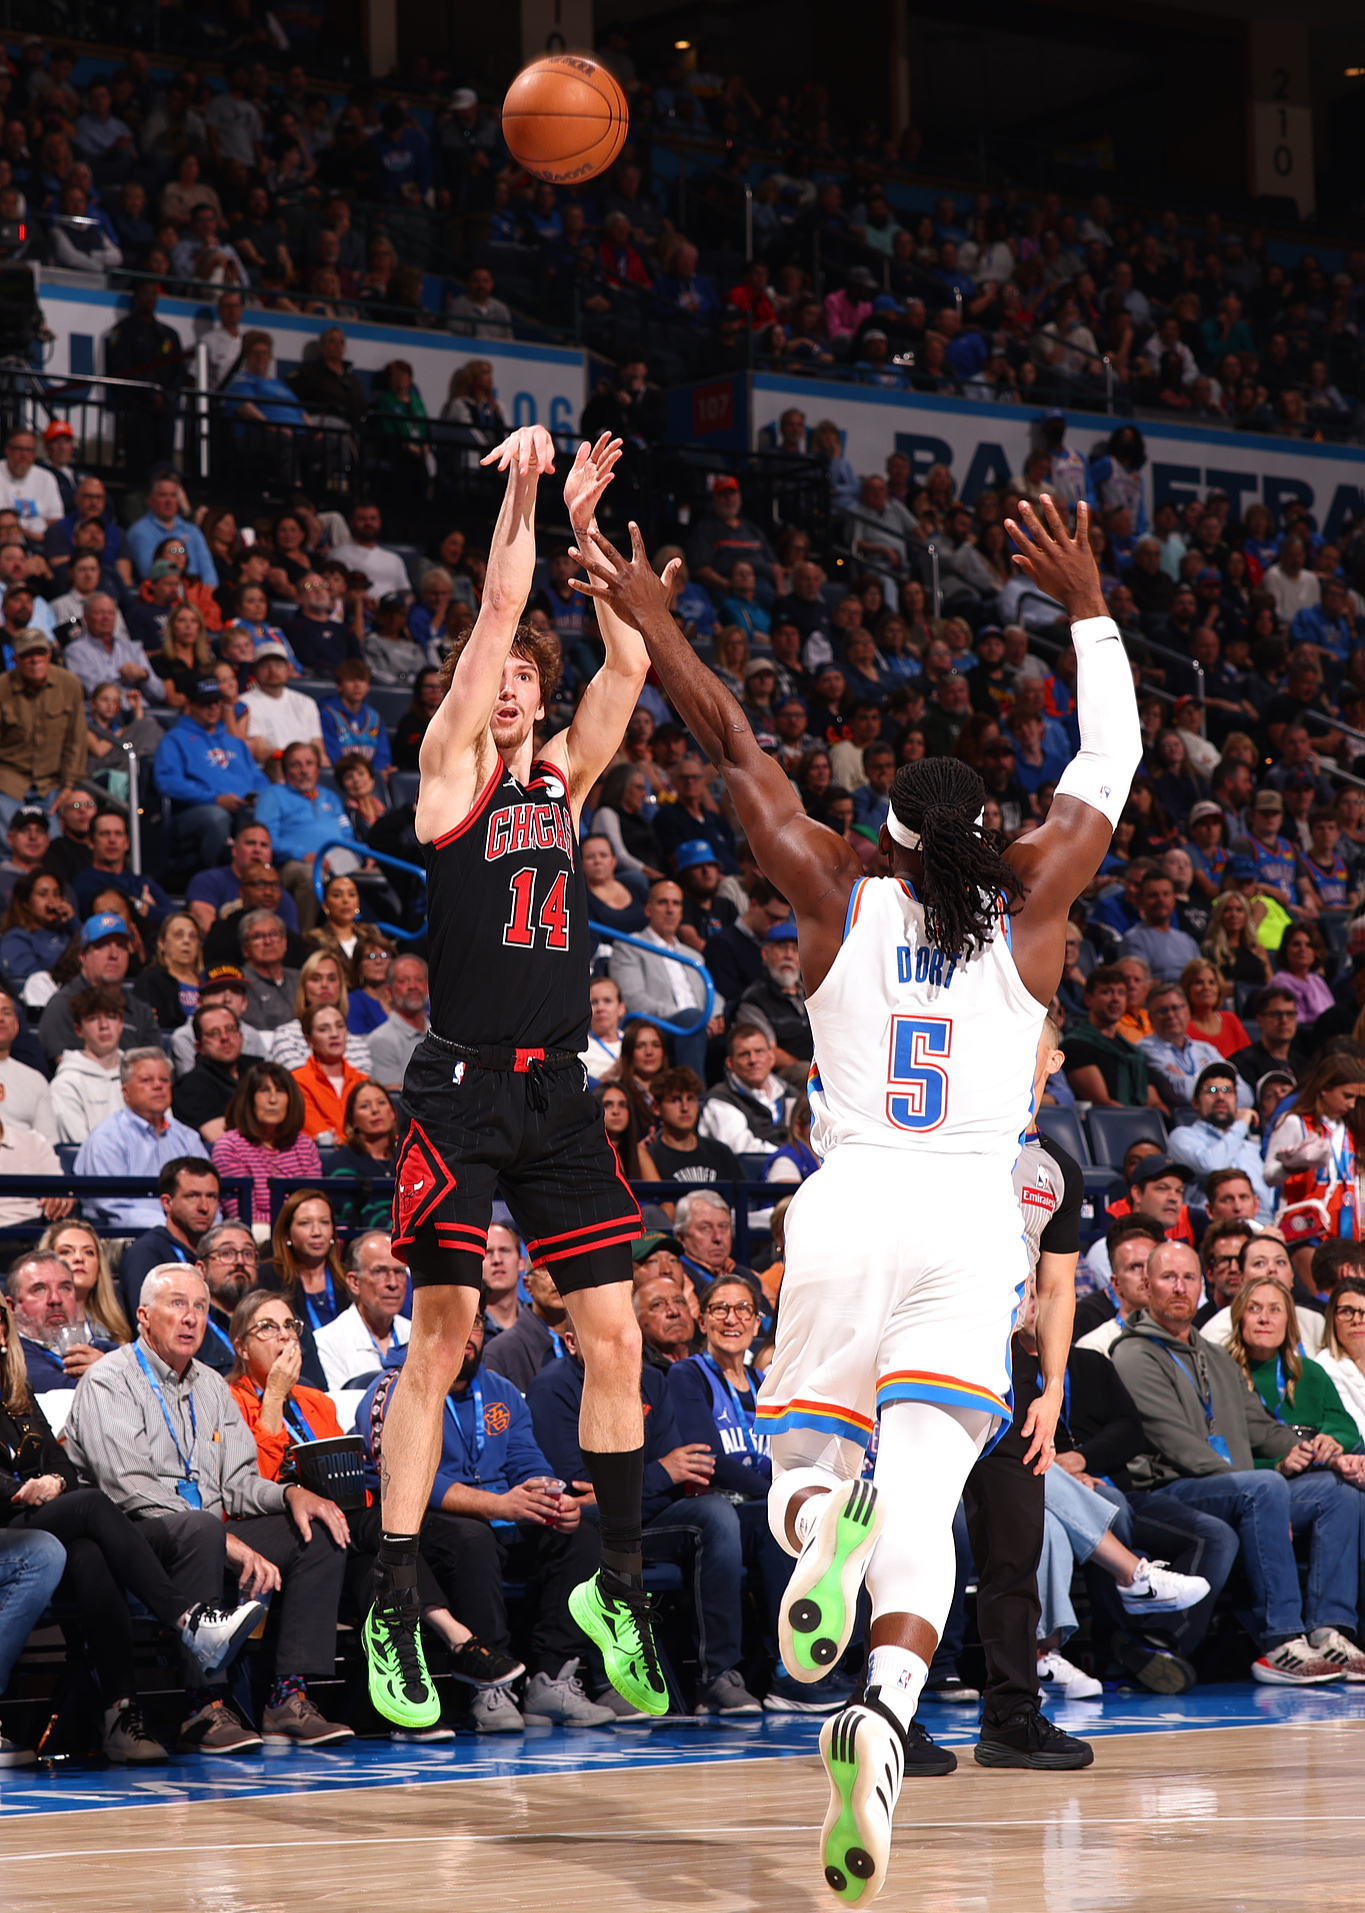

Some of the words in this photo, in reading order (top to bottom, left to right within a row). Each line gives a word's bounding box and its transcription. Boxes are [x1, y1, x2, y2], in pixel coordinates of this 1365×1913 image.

[1271, 68, 1293, 176] 210
[493, 388, 574, 454] 06
[698, 392, 731, 423] 107
[485, 802, 575, 874] CHCA
[502, 866, 570, 951] 14
[897, 946, 962, 989] DORT
[886, 1014, 953, 1133] 5
[1023, 1189, 1055, 1208] Emirates
[719, 1426, 748, 1455] ALL
[3, 1739, 818, 1802] MIDFIRST
